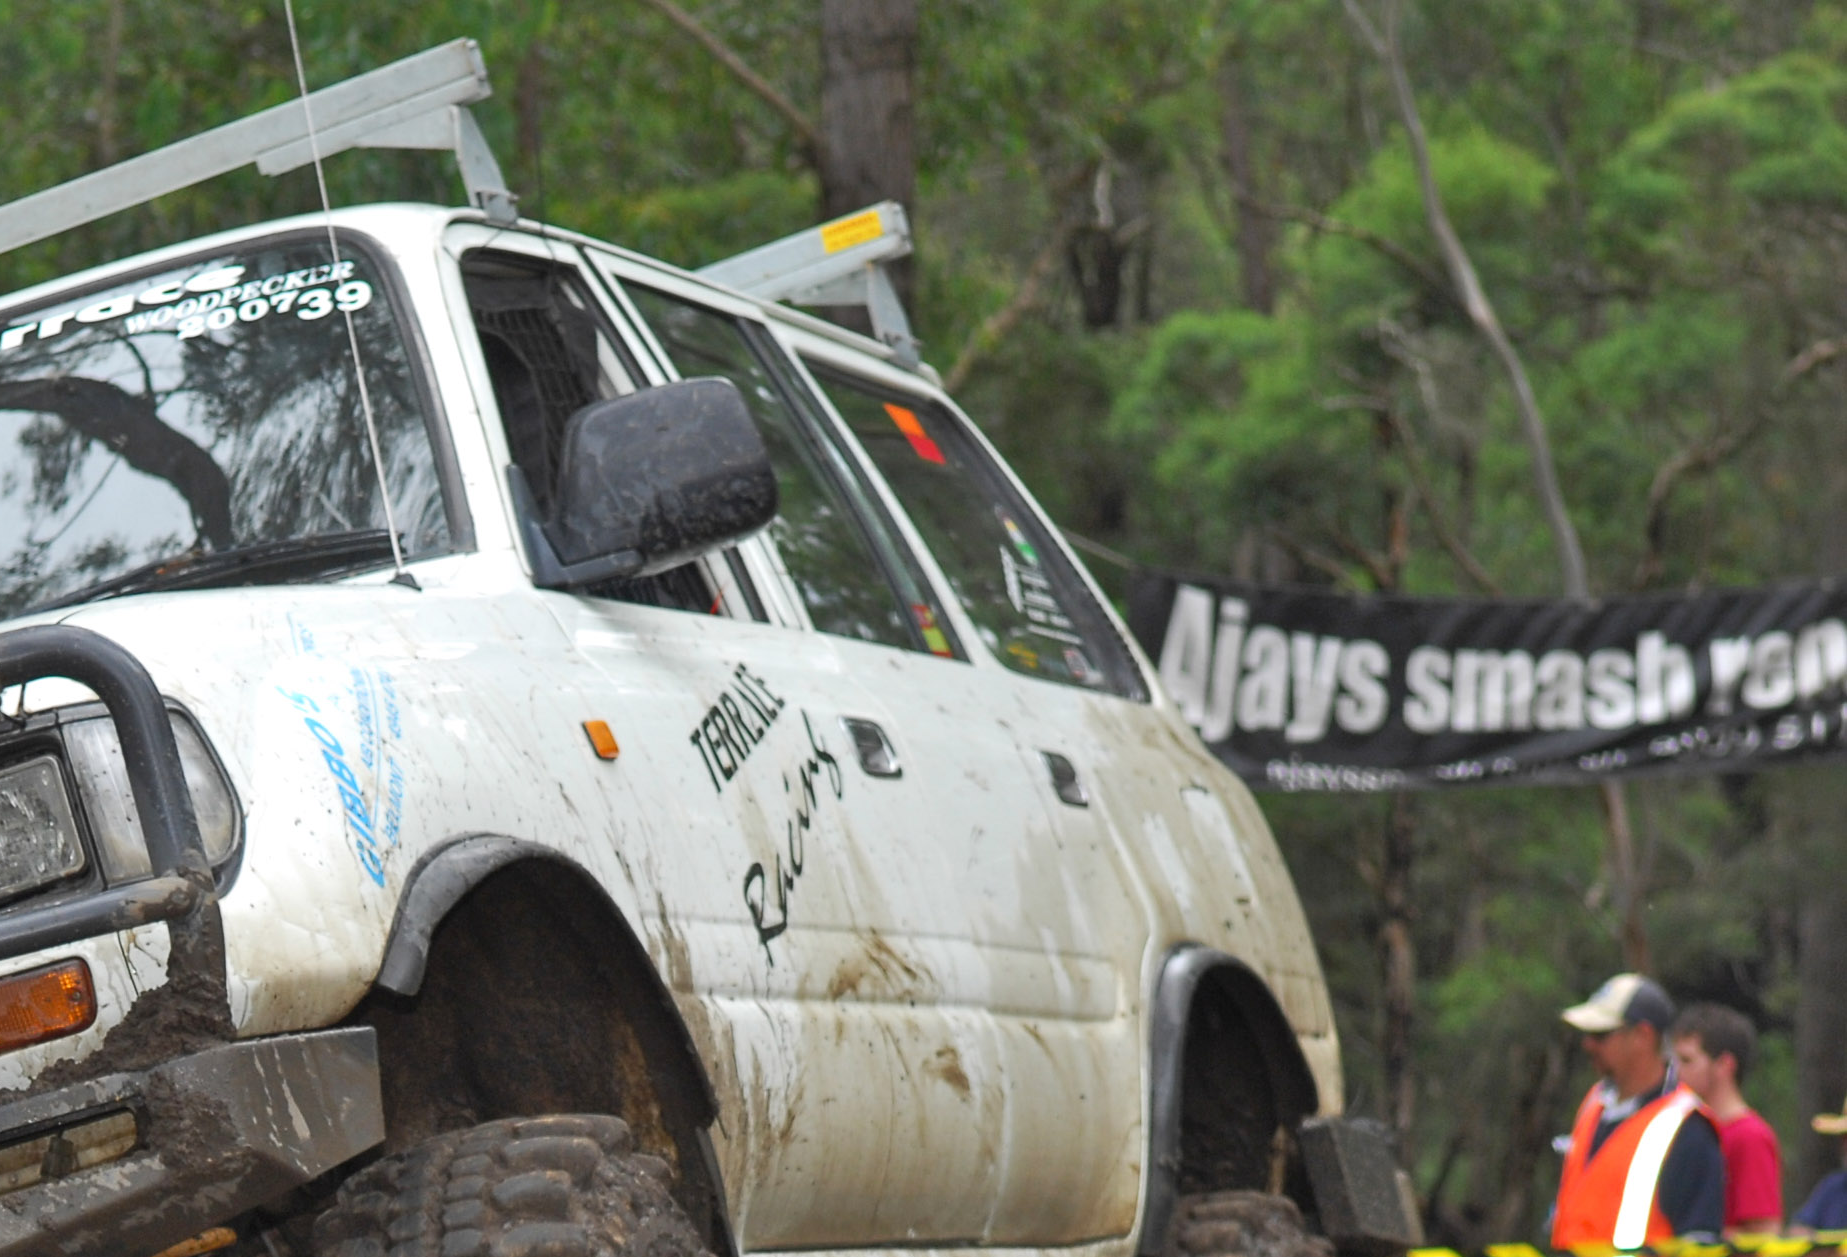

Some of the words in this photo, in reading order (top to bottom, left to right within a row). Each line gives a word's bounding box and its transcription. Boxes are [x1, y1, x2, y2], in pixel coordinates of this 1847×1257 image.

[124, 260, 355, 335] WOODPECKER
[177, 279, 373, 341] 200739
[1158, 583, 1391, 744] Ajays
[1403, 629, 1697, 734] smash
